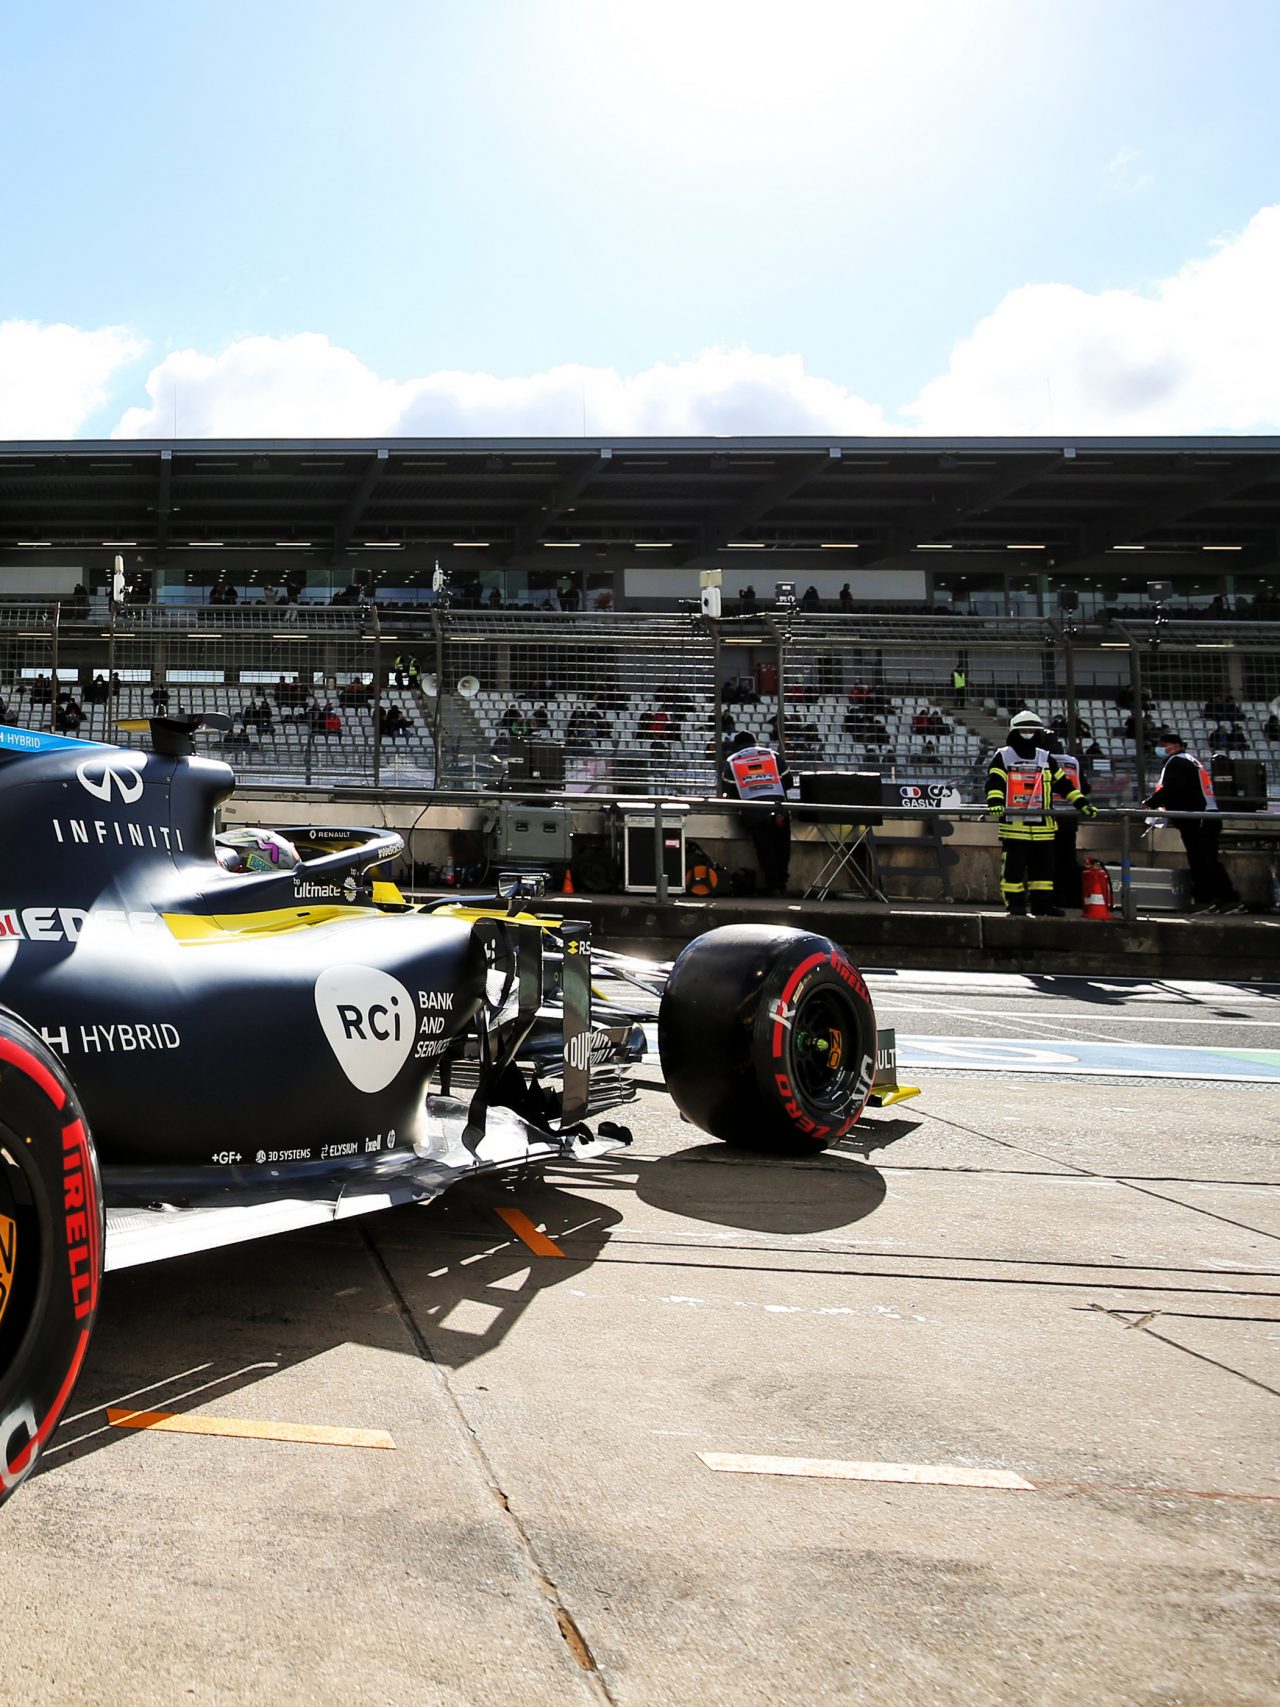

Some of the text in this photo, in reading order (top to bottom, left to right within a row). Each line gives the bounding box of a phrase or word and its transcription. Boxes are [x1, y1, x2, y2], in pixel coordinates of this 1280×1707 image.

[7, 733, 41, 749] HYBRID
[901, 798, 937, 808] GASLY
[52, 818, 184, 852] INFINITI
[294, 881, 341, 899] ultimate
[418, 990, 454, 1011] BANK
[419, 1016, 446, 1035] AND
[79, 1023, 181, 1053] HYBRID
[267, 1148, 311, 1162] 3D SYSTEMS
[329, 1142, 358, 1158] ELYSIUM
[61, 1117, 99, 1321] PIRELLI
